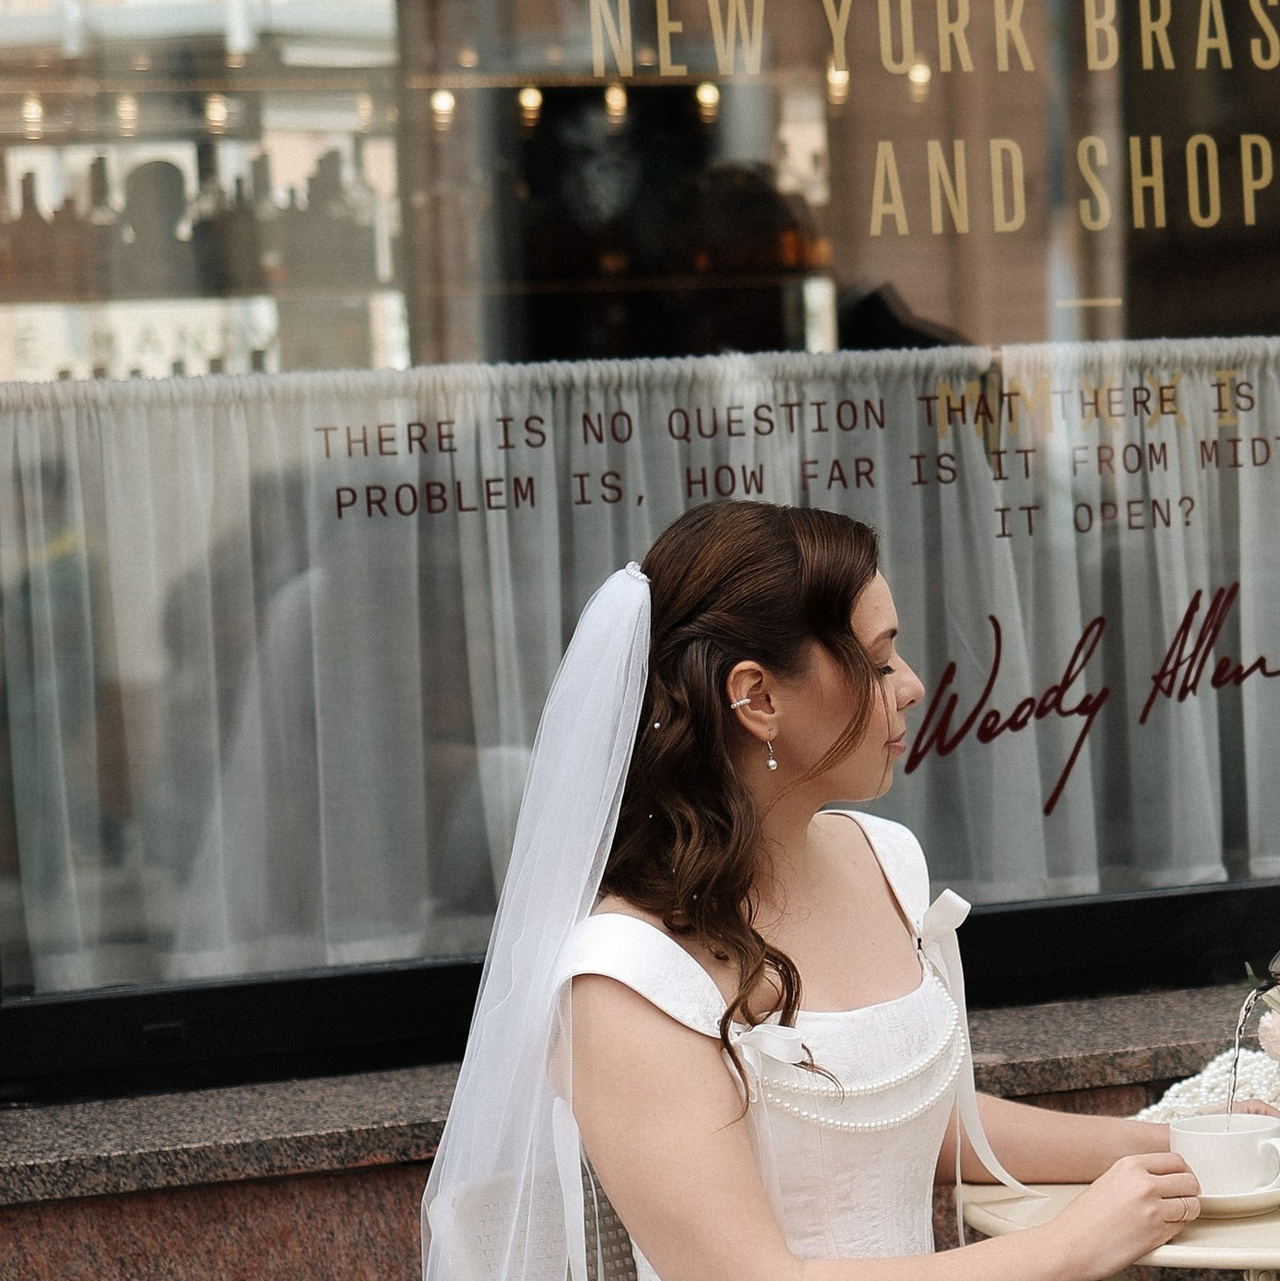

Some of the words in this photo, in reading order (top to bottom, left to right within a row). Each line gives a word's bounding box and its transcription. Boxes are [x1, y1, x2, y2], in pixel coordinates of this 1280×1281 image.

[869, 138, 1027, 237] AND
[1076, 133, 1274, 231] SHOP
[314, 420, 458, 460] THERE
[495, 415, 547, 450] IS
[581, 410, 634, 445] NO
[667, 398, 886, 444] QUESTION
[917, 391, 1021, 426] THAT
[1051, 384, 1179, 421] THERE
[1210, 381, 1256, 414] IS
[335, 476, 536, 520] PROBLEM
[572, 470, 645, 507] IS,
[685, 463, 765, 499] HOW
[800, 457, 876, 491] FAR
[909, 452, 958, 486] IS
[991, 448, 1037, 481] IT
[1071, 442, 1168, 477] FROM
[994, 505, 1040, 538] IT
[1072, 495, 1196, 534] OPEN?
